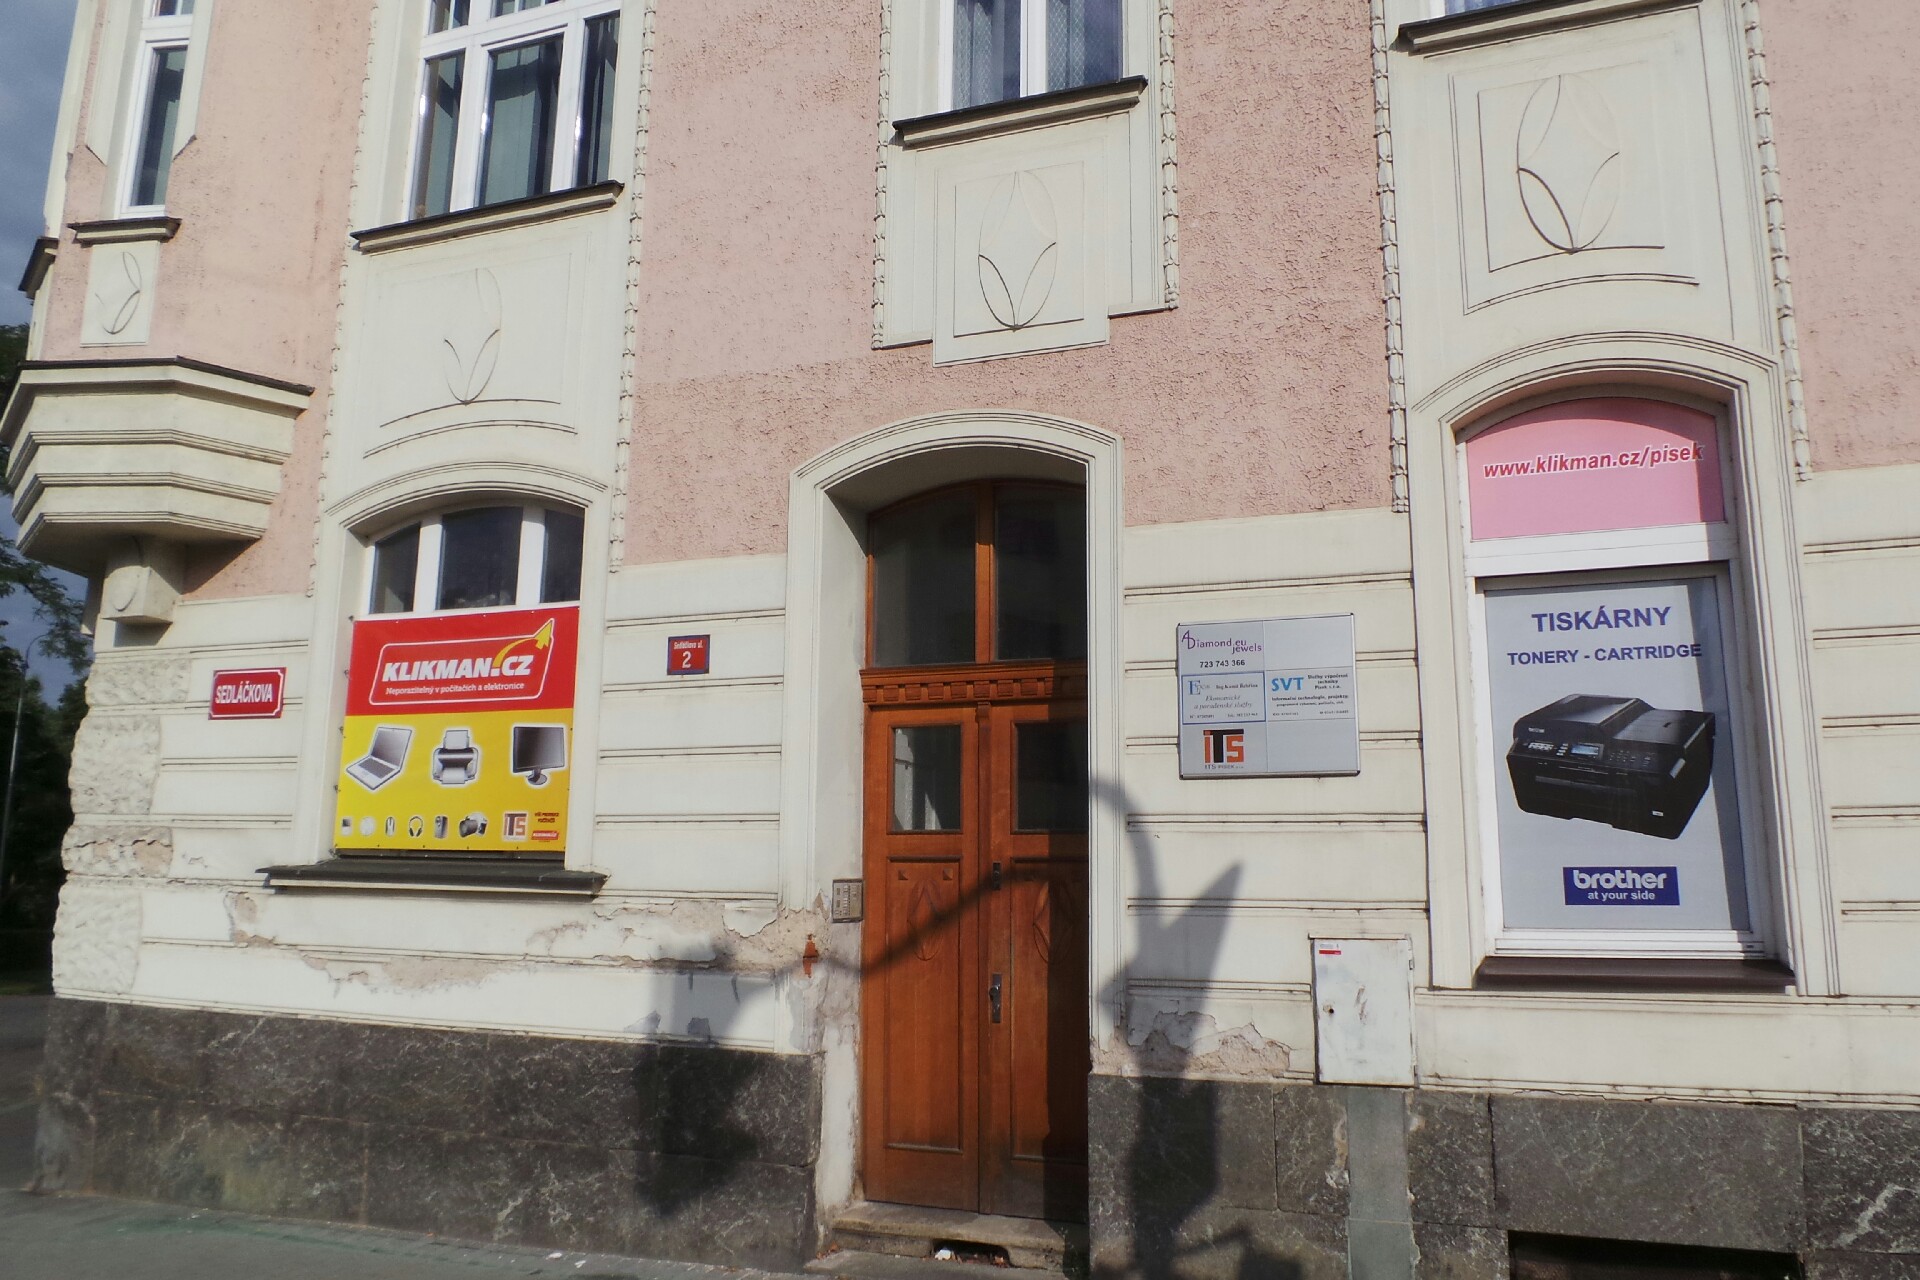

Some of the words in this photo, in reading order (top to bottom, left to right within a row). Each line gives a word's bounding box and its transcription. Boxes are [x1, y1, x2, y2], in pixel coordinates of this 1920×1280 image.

[1484, 442, 1705, 478] www.klikman.cz/pisek
[1531, 605, 1671, 632] TISKÁRNY
[1232, 643, 1262, 655] jewels
[1507, 650, 1579, 665] TONERY
[1594, 643, 1702, 662] CARTRIDGE
[382, 655, 534, 682] KLIKMAN.CZ
[682, 650, 692, 669] 2
[215, 680, 273, 704] SEDLÁČKOVA
[483, 681, 525, 691] elektronice
[1271, 677, 1304, 692] SVT
[1573, 869, 1668, 889] brother
[1587, 891, 1599, 900] at
[1601, 891, 1628, 902] your
[1631, 890, 1656, 900] side
